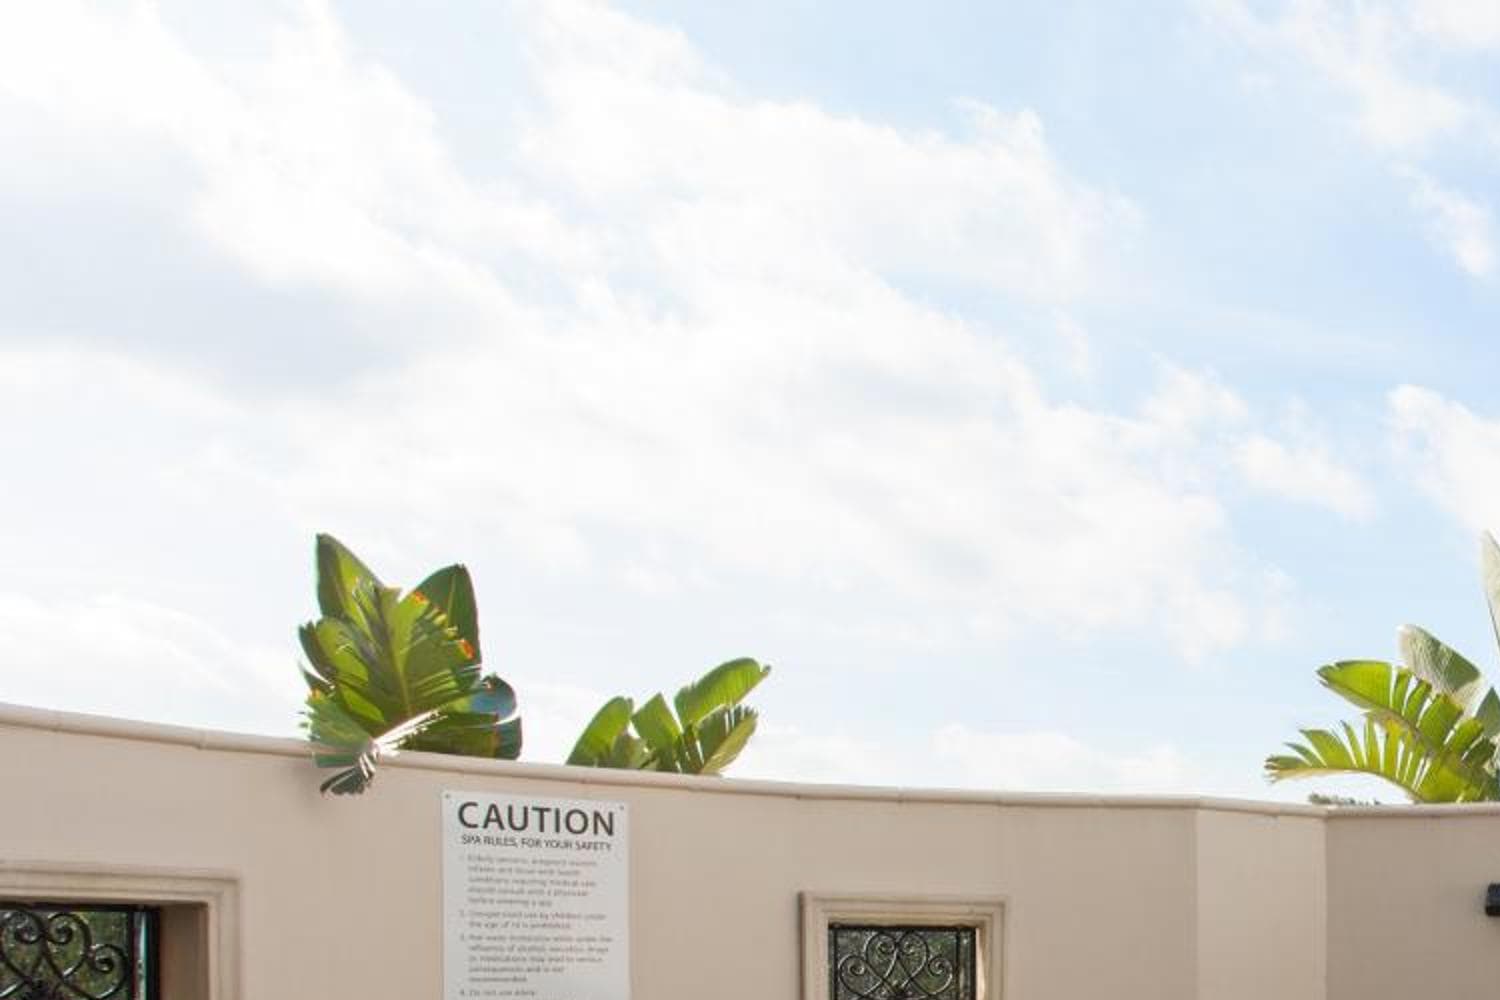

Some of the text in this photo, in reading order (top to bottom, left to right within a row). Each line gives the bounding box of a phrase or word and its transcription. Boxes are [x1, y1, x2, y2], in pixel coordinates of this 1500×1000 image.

[458, 801, 614, 836] CAUTION
[461, 834, 481, 845] SPA
[521, 836, 542, 848] FOR
[545, 837, 573, 849] YOUR
[575, 839, 612, 851] SAFETY
